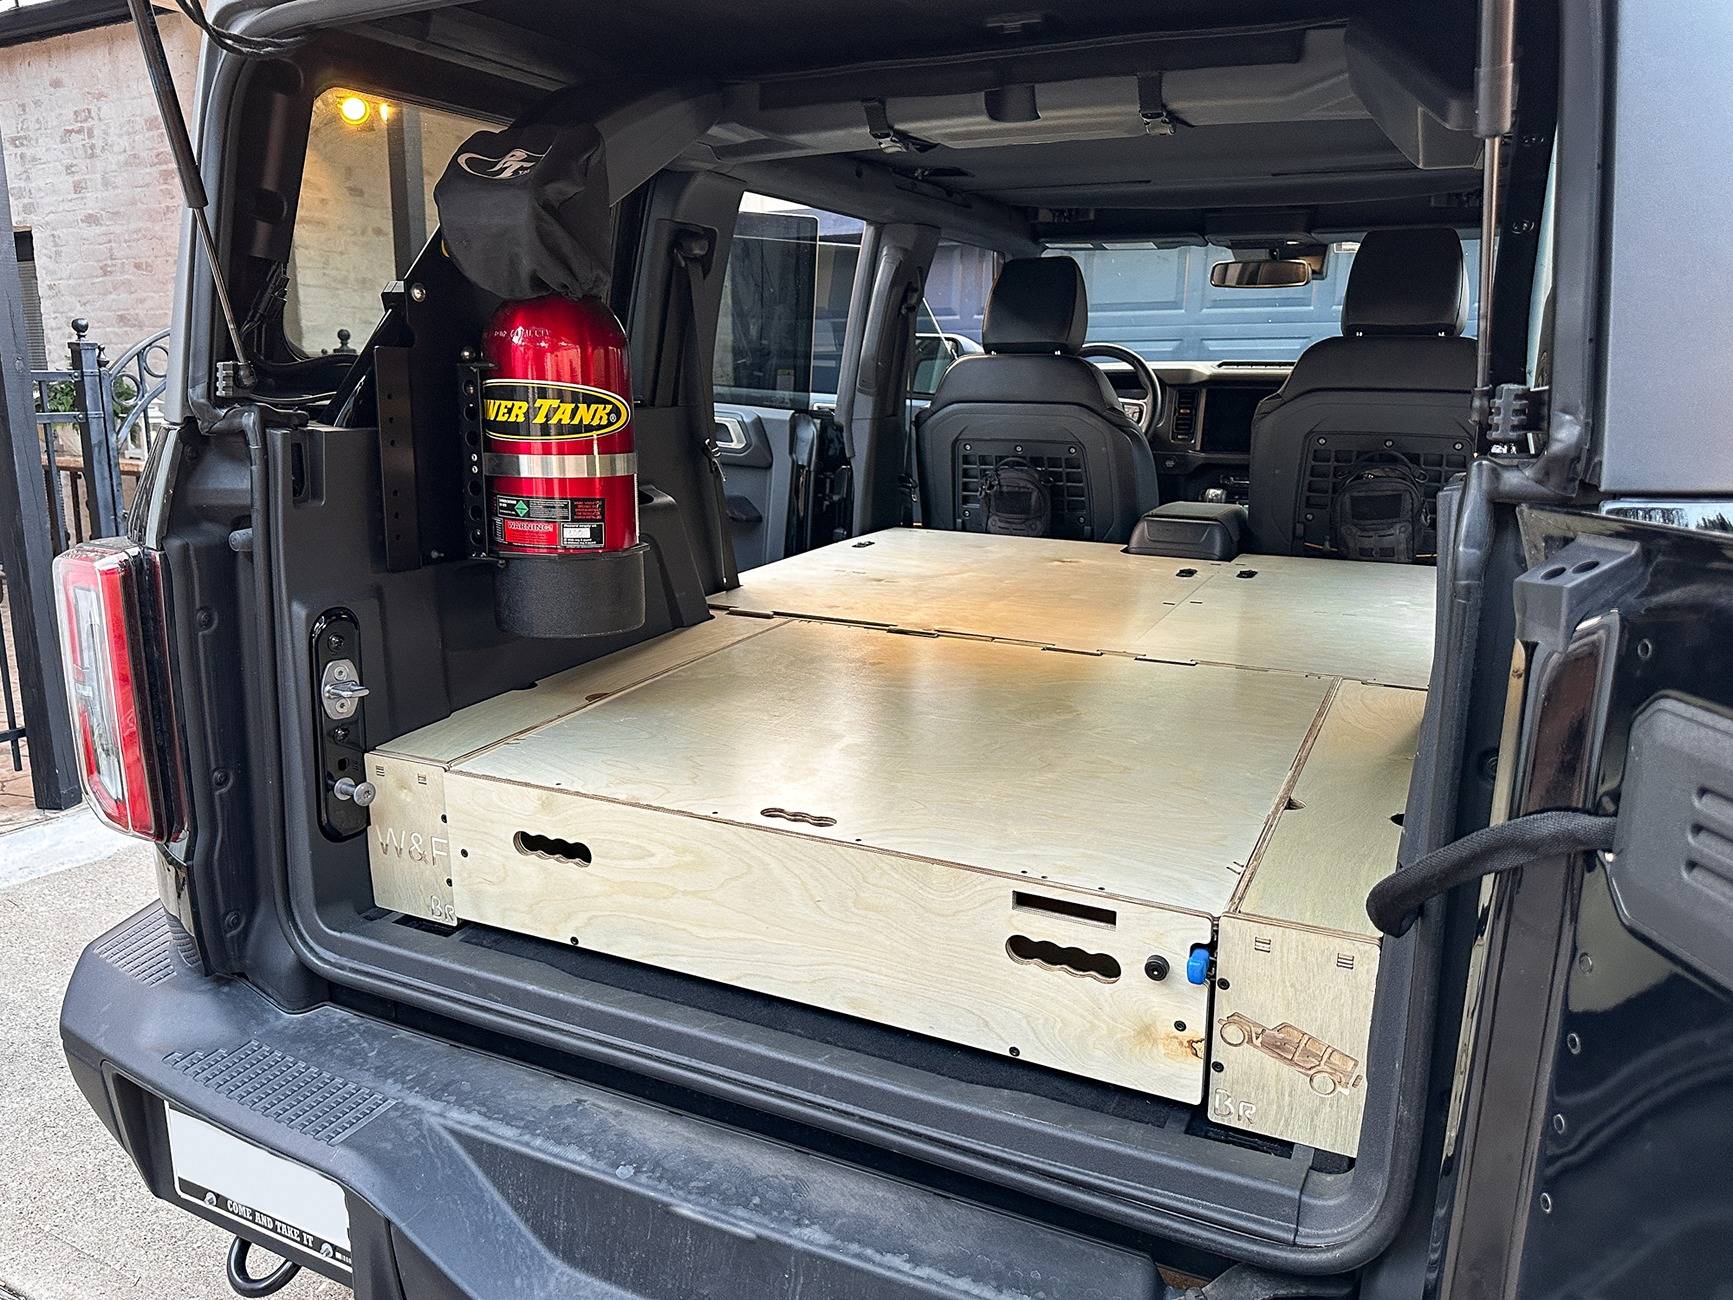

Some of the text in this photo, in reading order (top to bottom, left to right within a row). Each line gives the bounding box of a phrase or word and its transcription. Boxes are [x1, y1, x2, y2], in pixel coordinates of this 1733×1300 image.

[376, 825, 448, 866] W&F
[1214, 1088, 1256, 1124] BR
[227, 1199, 314, 1247] COME AND TAKE IT
